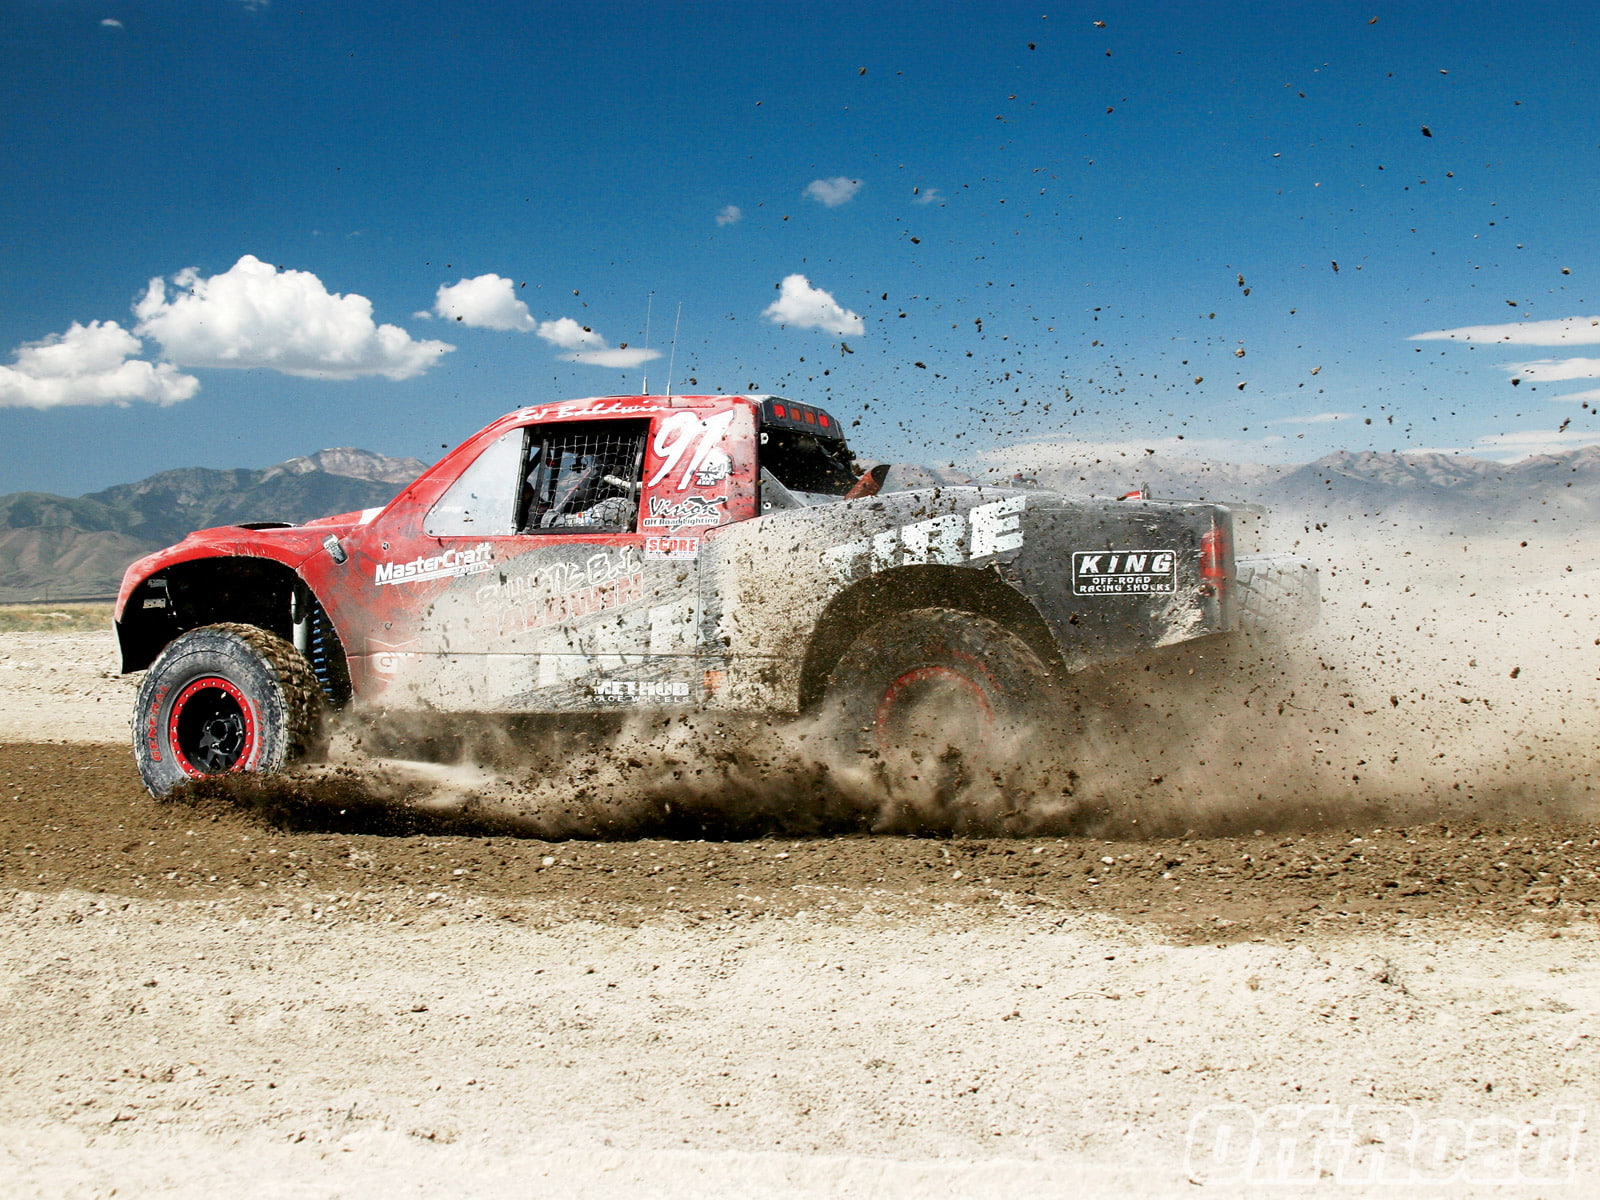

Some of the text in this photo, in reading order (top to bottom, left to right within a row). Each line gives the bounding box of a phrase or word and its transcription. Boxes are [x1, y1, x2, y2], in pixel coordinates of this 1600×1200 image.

[649, 496, 721, 518] Vision
[649, 539, 696, 552] SCORE
[375, 542, 492, 583] MasterCraft
[1079, 553, 1172, 574] KING
[1080, 583, 1171, 593] RACING SHOCKS
[1092, 576, 1151, 585] OFF-ROAD
[147, 684, 171, 762] GENERAL
